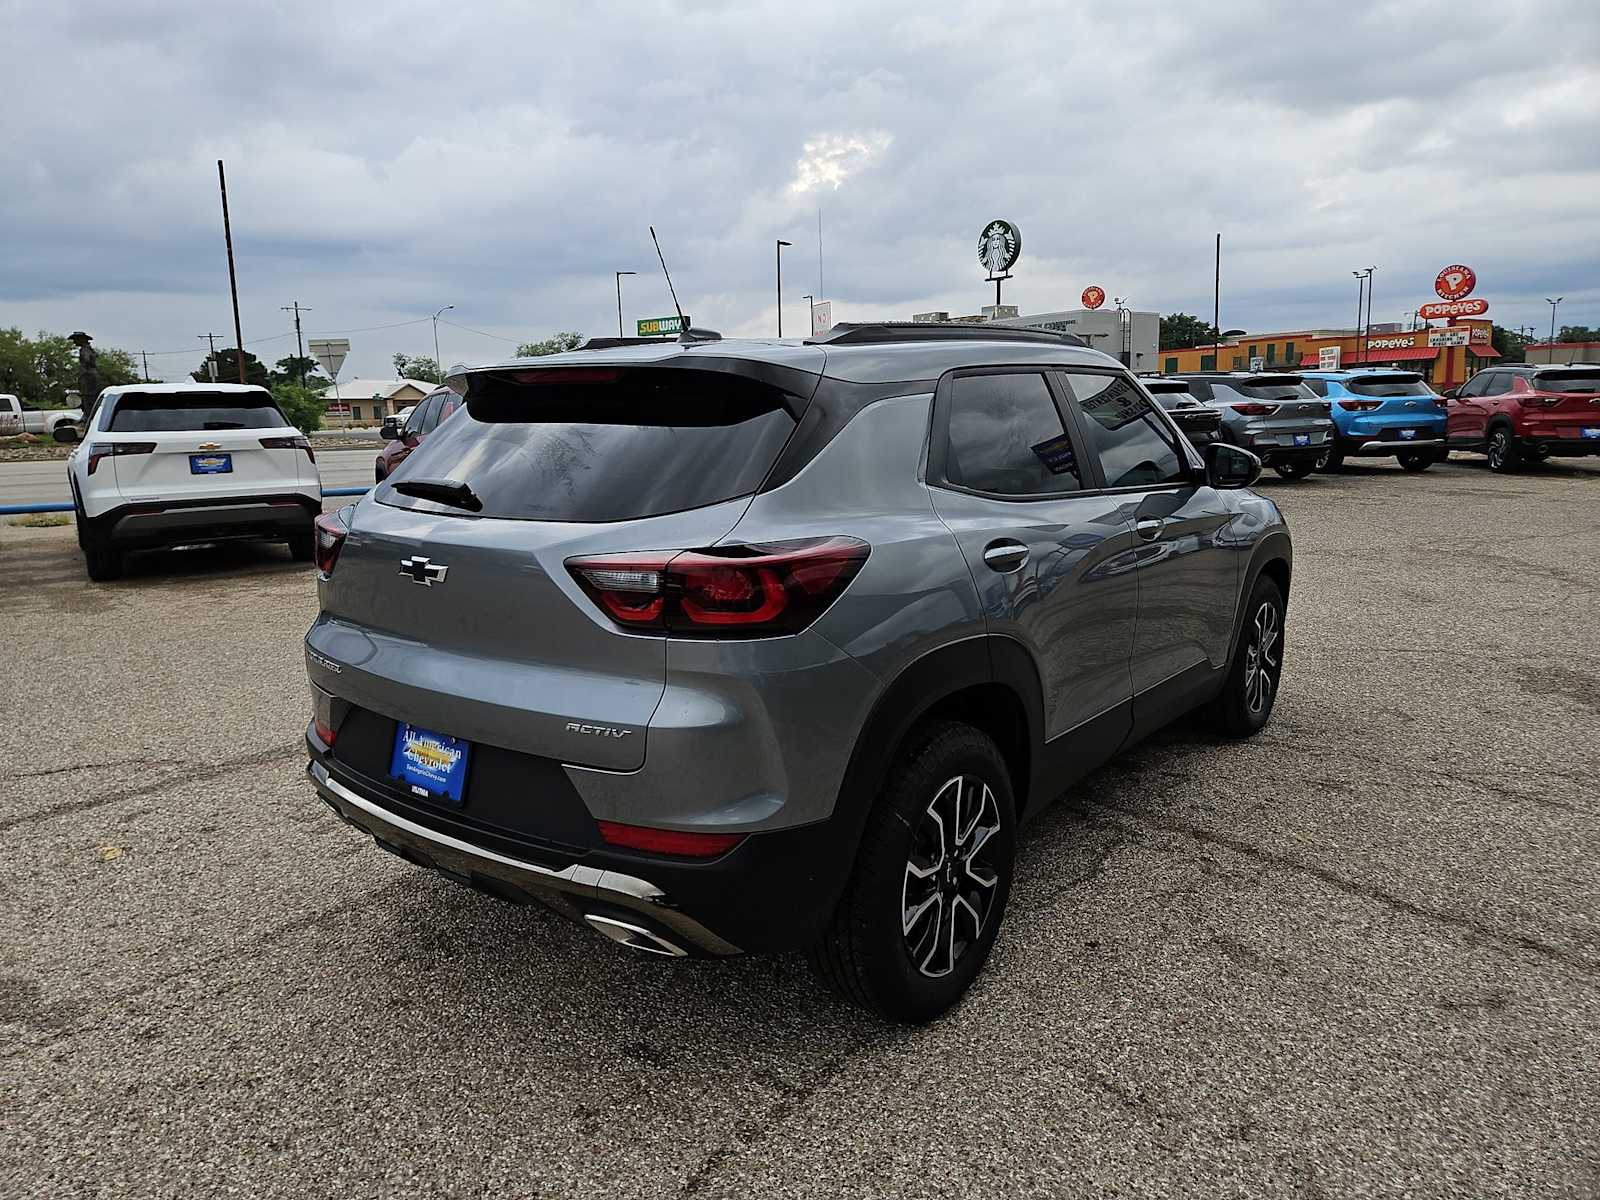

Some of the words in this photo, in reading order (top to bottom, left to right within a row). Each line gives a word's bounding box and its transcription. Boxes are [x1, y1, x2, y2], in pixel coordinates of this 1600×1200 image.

[640, 320, 681, 332] SUBWAY
[565, 722, 632, 738] ACTIV
[417, 735, 461, 759] American
[407, 748, 450, 773] Chevrolet
